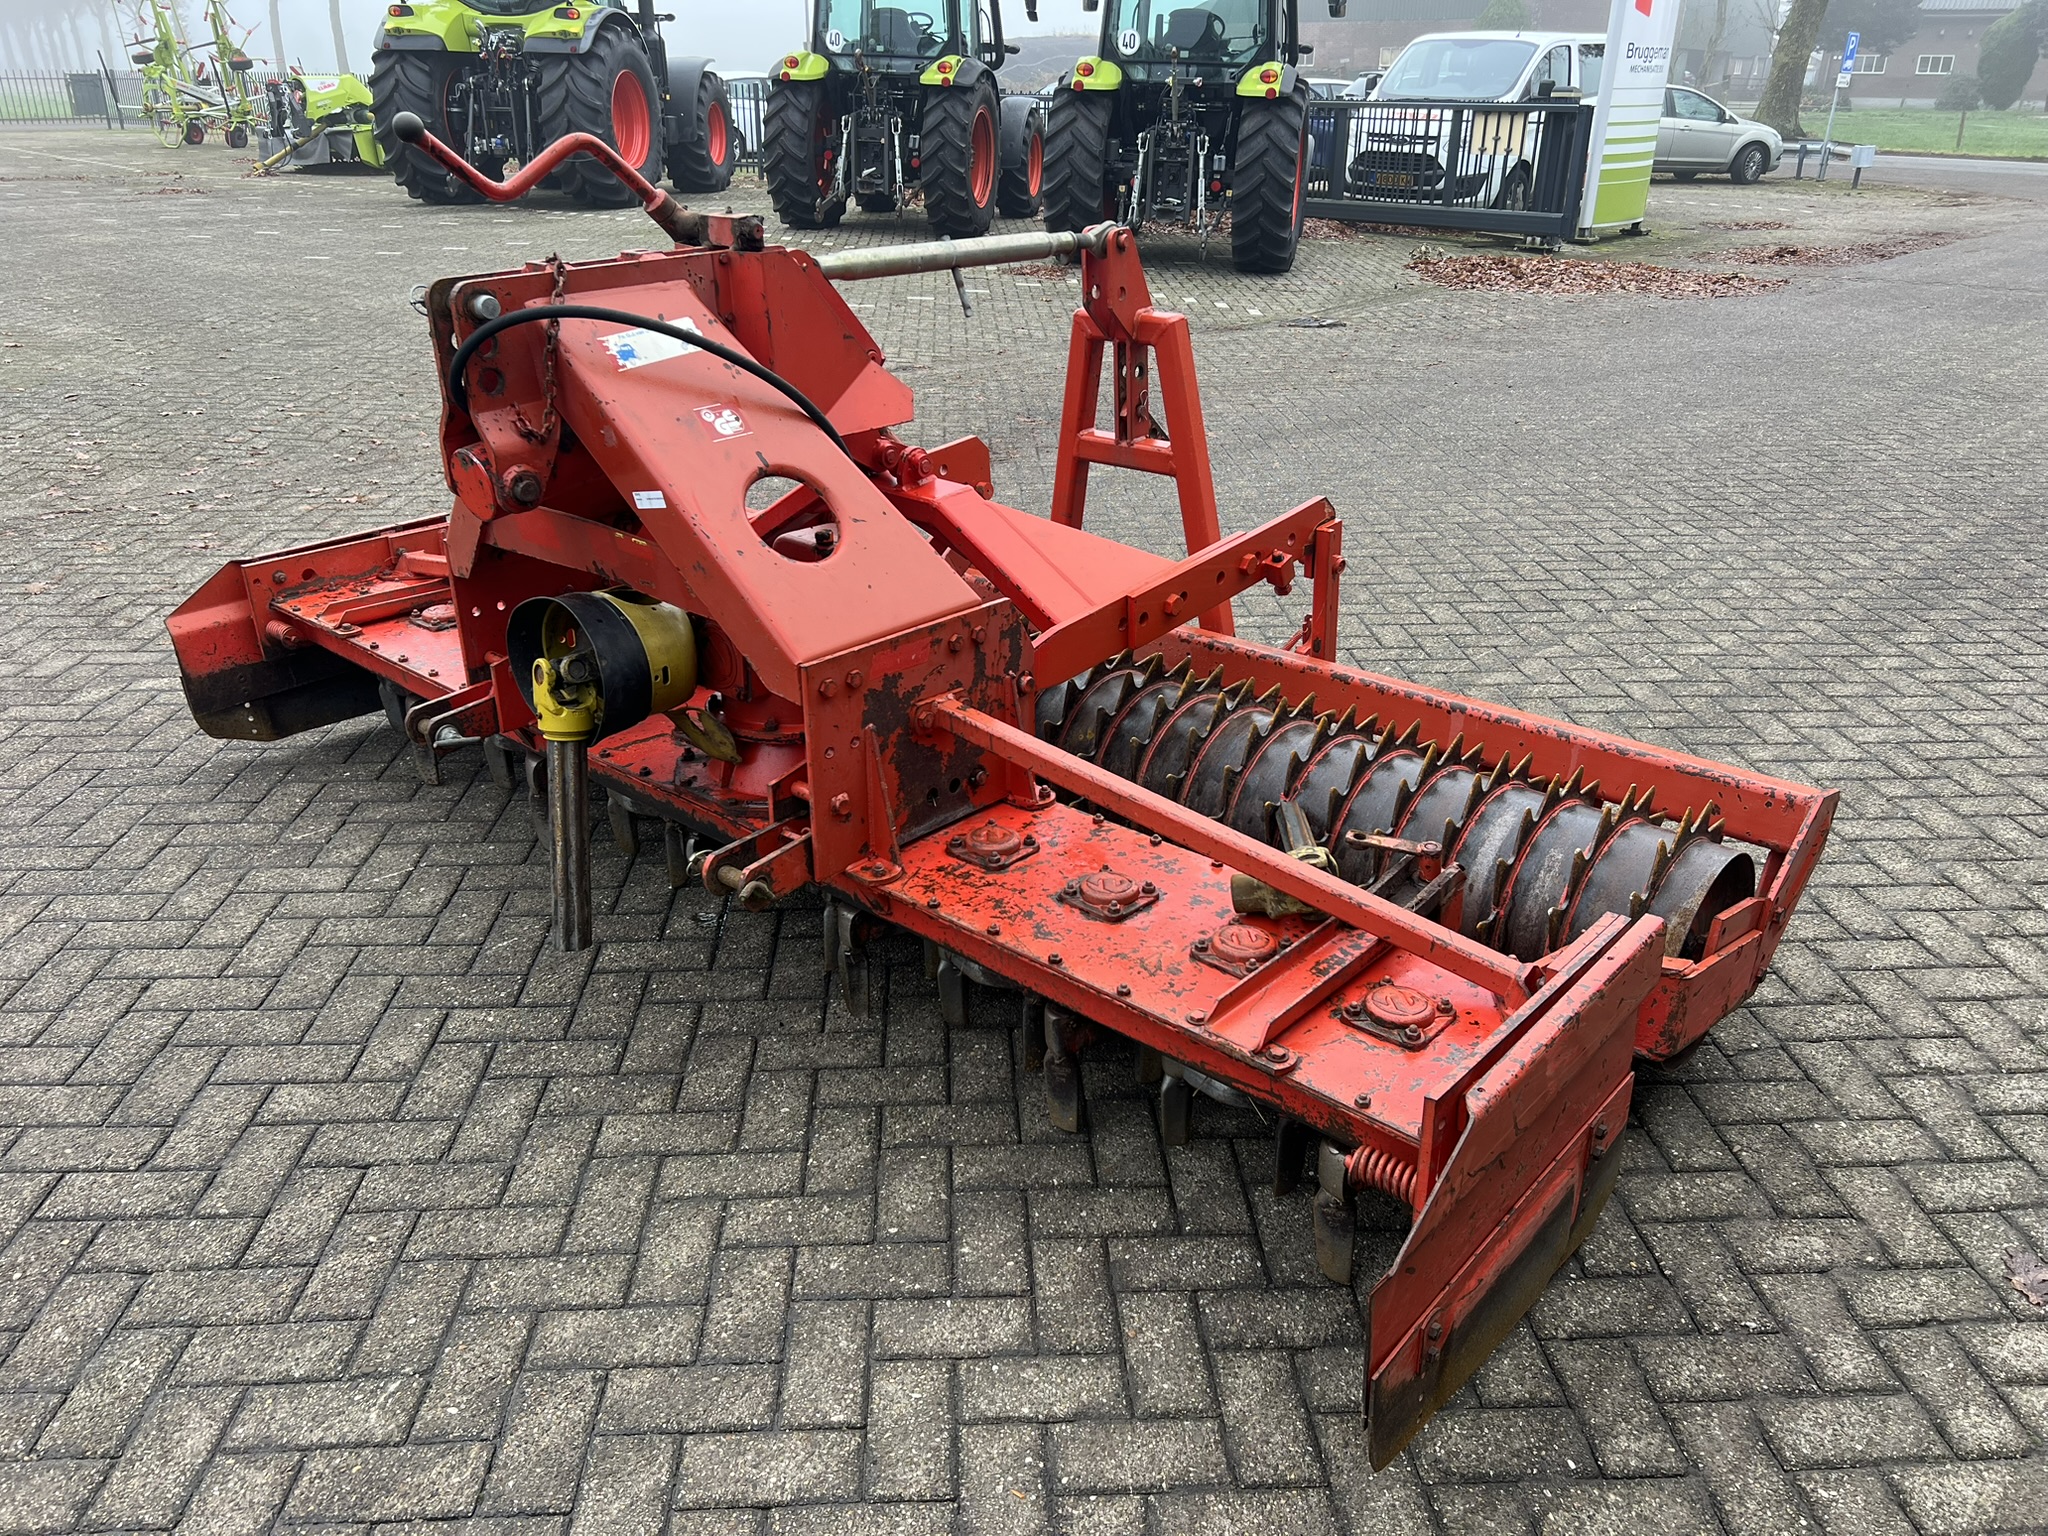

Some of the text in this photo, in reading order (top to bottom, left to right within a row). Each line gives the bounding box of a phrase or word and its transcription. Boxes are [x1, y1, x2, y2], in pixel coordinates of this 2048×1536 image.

[829, 32, 842, 47] 40
[1122, 33, 1136, 50] 40
[1847, 36, 1857, 56] P
[1626, 42, 1670, 64] Bruggeman
